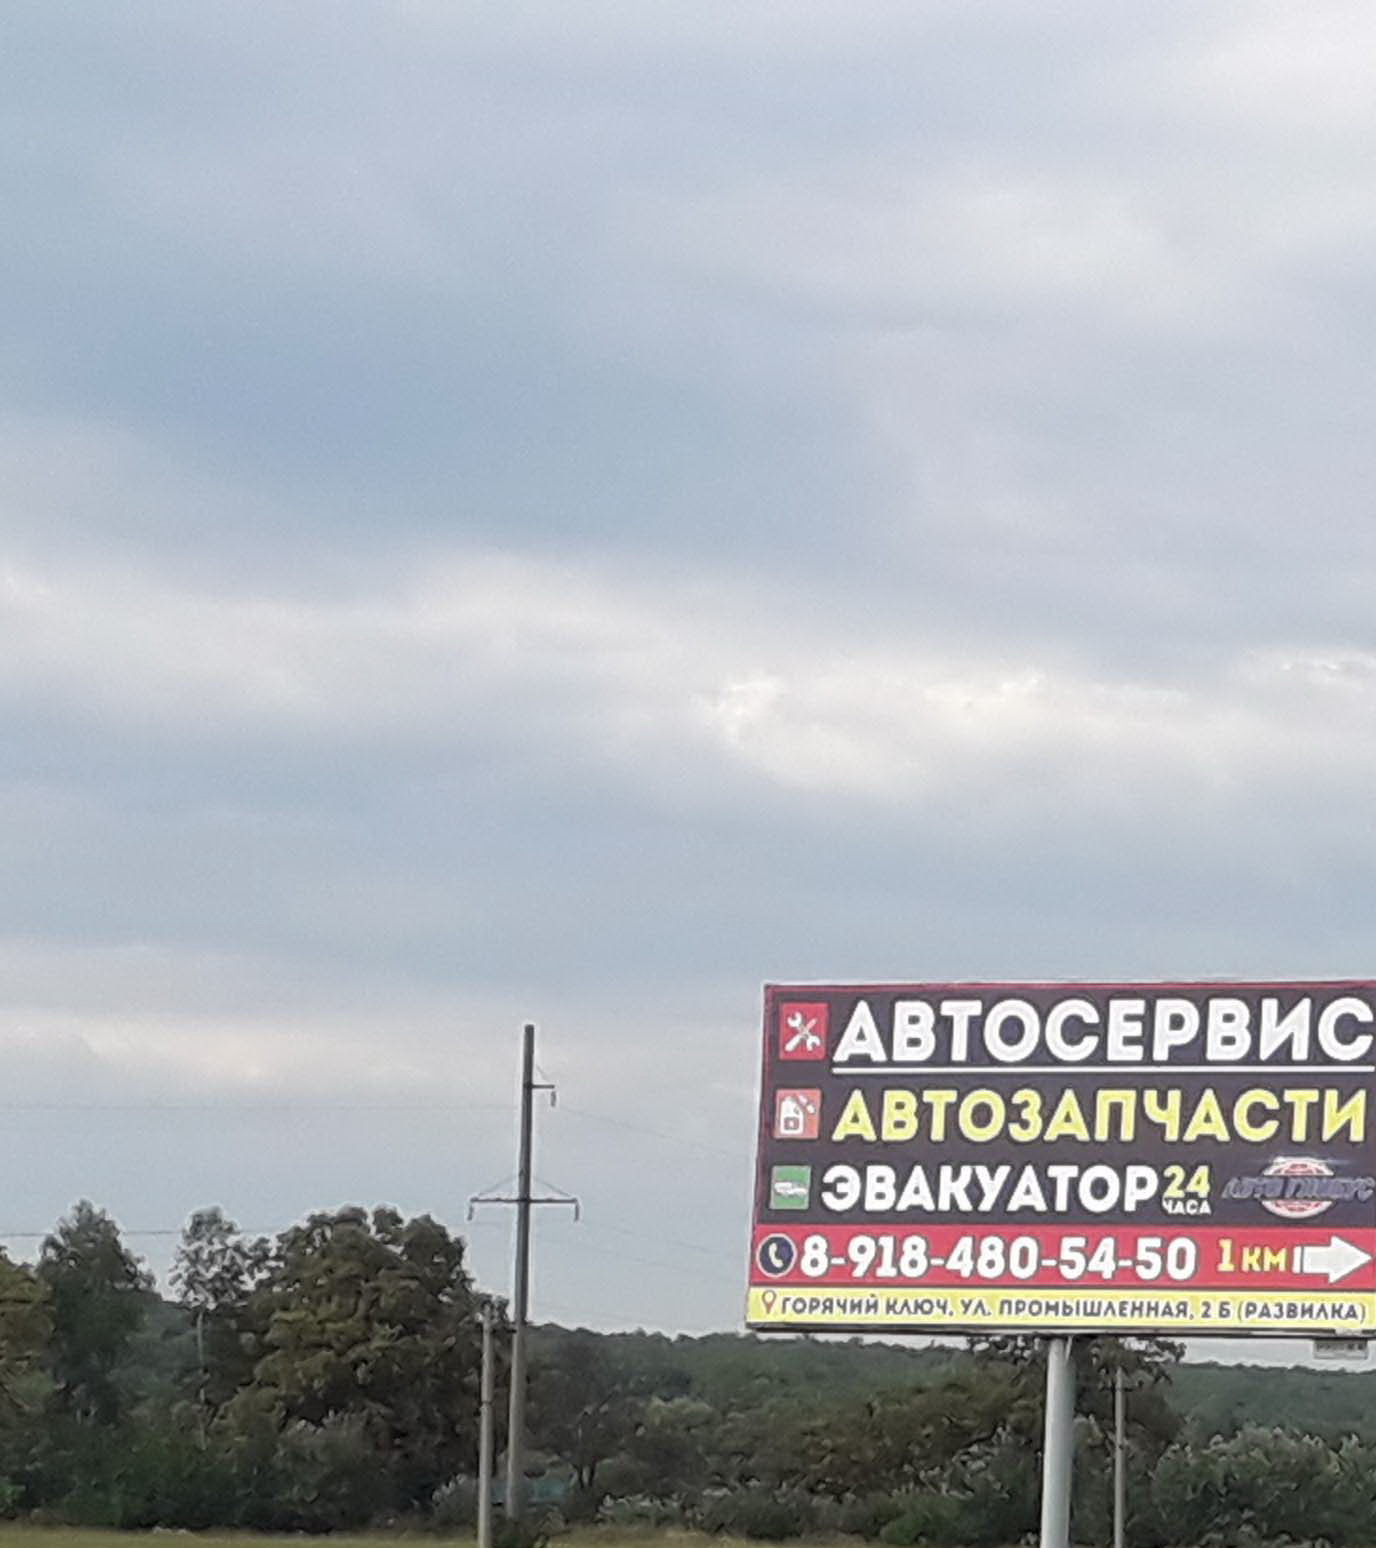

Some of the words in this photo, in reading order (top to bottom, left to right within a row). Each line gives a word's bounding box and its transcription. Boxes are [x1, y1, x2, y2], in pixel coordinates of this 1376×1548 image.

[833, 998, 1376, 1063] АВТОСЕРВИС
[831, 1088, 1367, 1142] АВТОЗАПЧАСТИ
[820, 1164, 1159, 1211] ЭВАКУАТОР
[1163, 1166, 1211, 1198] 24
[1163, 1200, 1212, 1215] ЧАСА
[800, 1234, 1197, 1281] 8-918-480-54-50
[1216, 1239, 1235, 1272] 1
[781, 1293, 880, 1315] ГОРЯЧИЙ
[885, 1298, 955, 1317] КЛЮЧ,
[961, 1299, 992, 1316] УЛ.
[999, 1300, 1194, 1321] ПРОМЫШЛЕННАЯ,
[1201, 1302, 1212, 1318] 2
[1218, 1302, 1231, 1318] Б
[1237, 1301, 1367, 1322] (РАЗВИЛКА)
